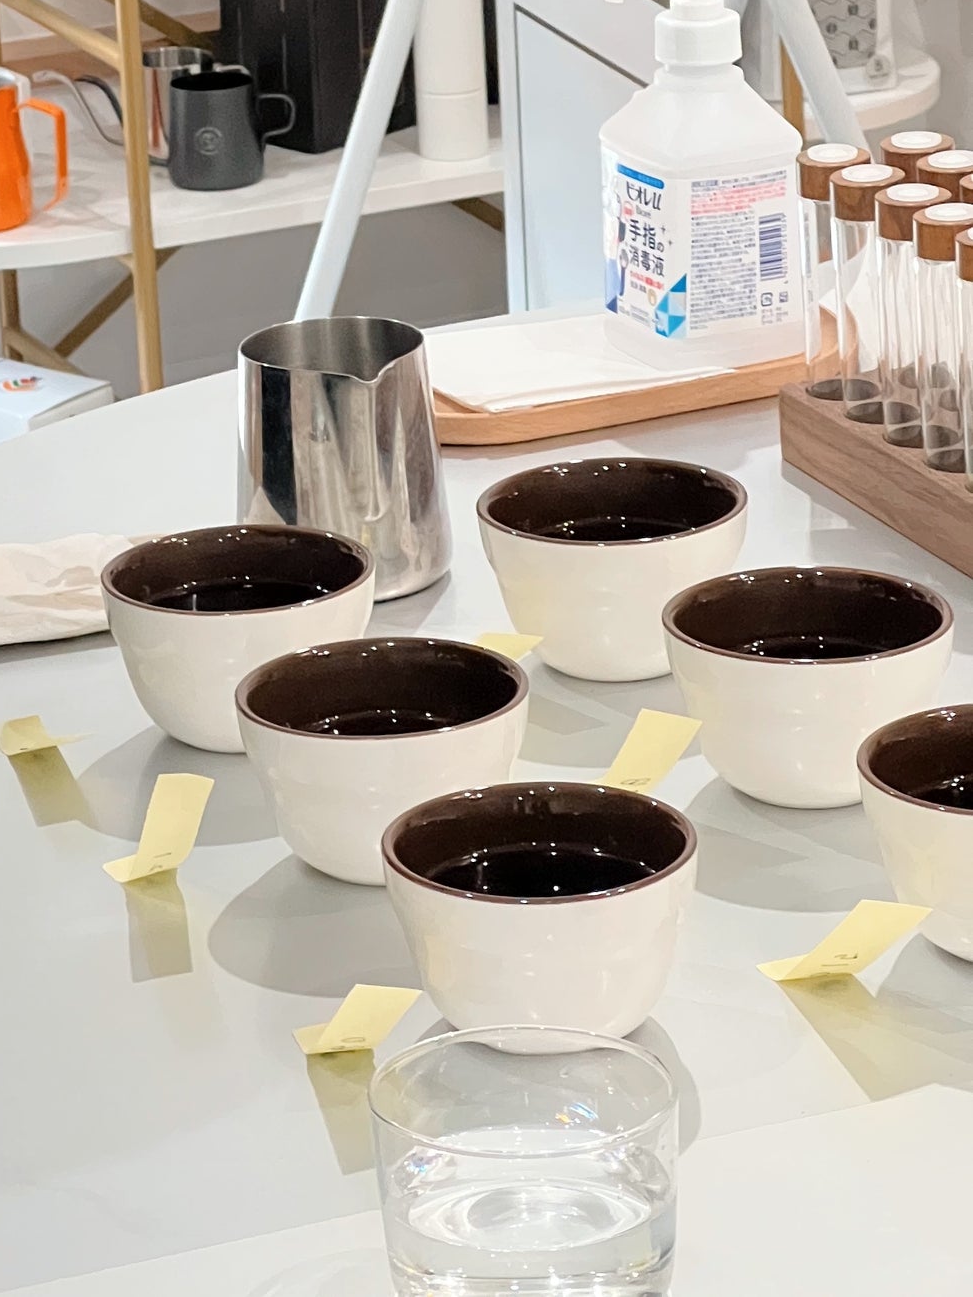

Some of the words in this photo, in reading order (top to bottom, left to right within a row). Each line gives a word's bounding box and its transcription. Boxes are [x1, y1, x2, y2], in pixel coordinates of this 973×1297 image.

[628, 218, 665, 253] 手指の
[628, 244, 665, 278] 消毒液
